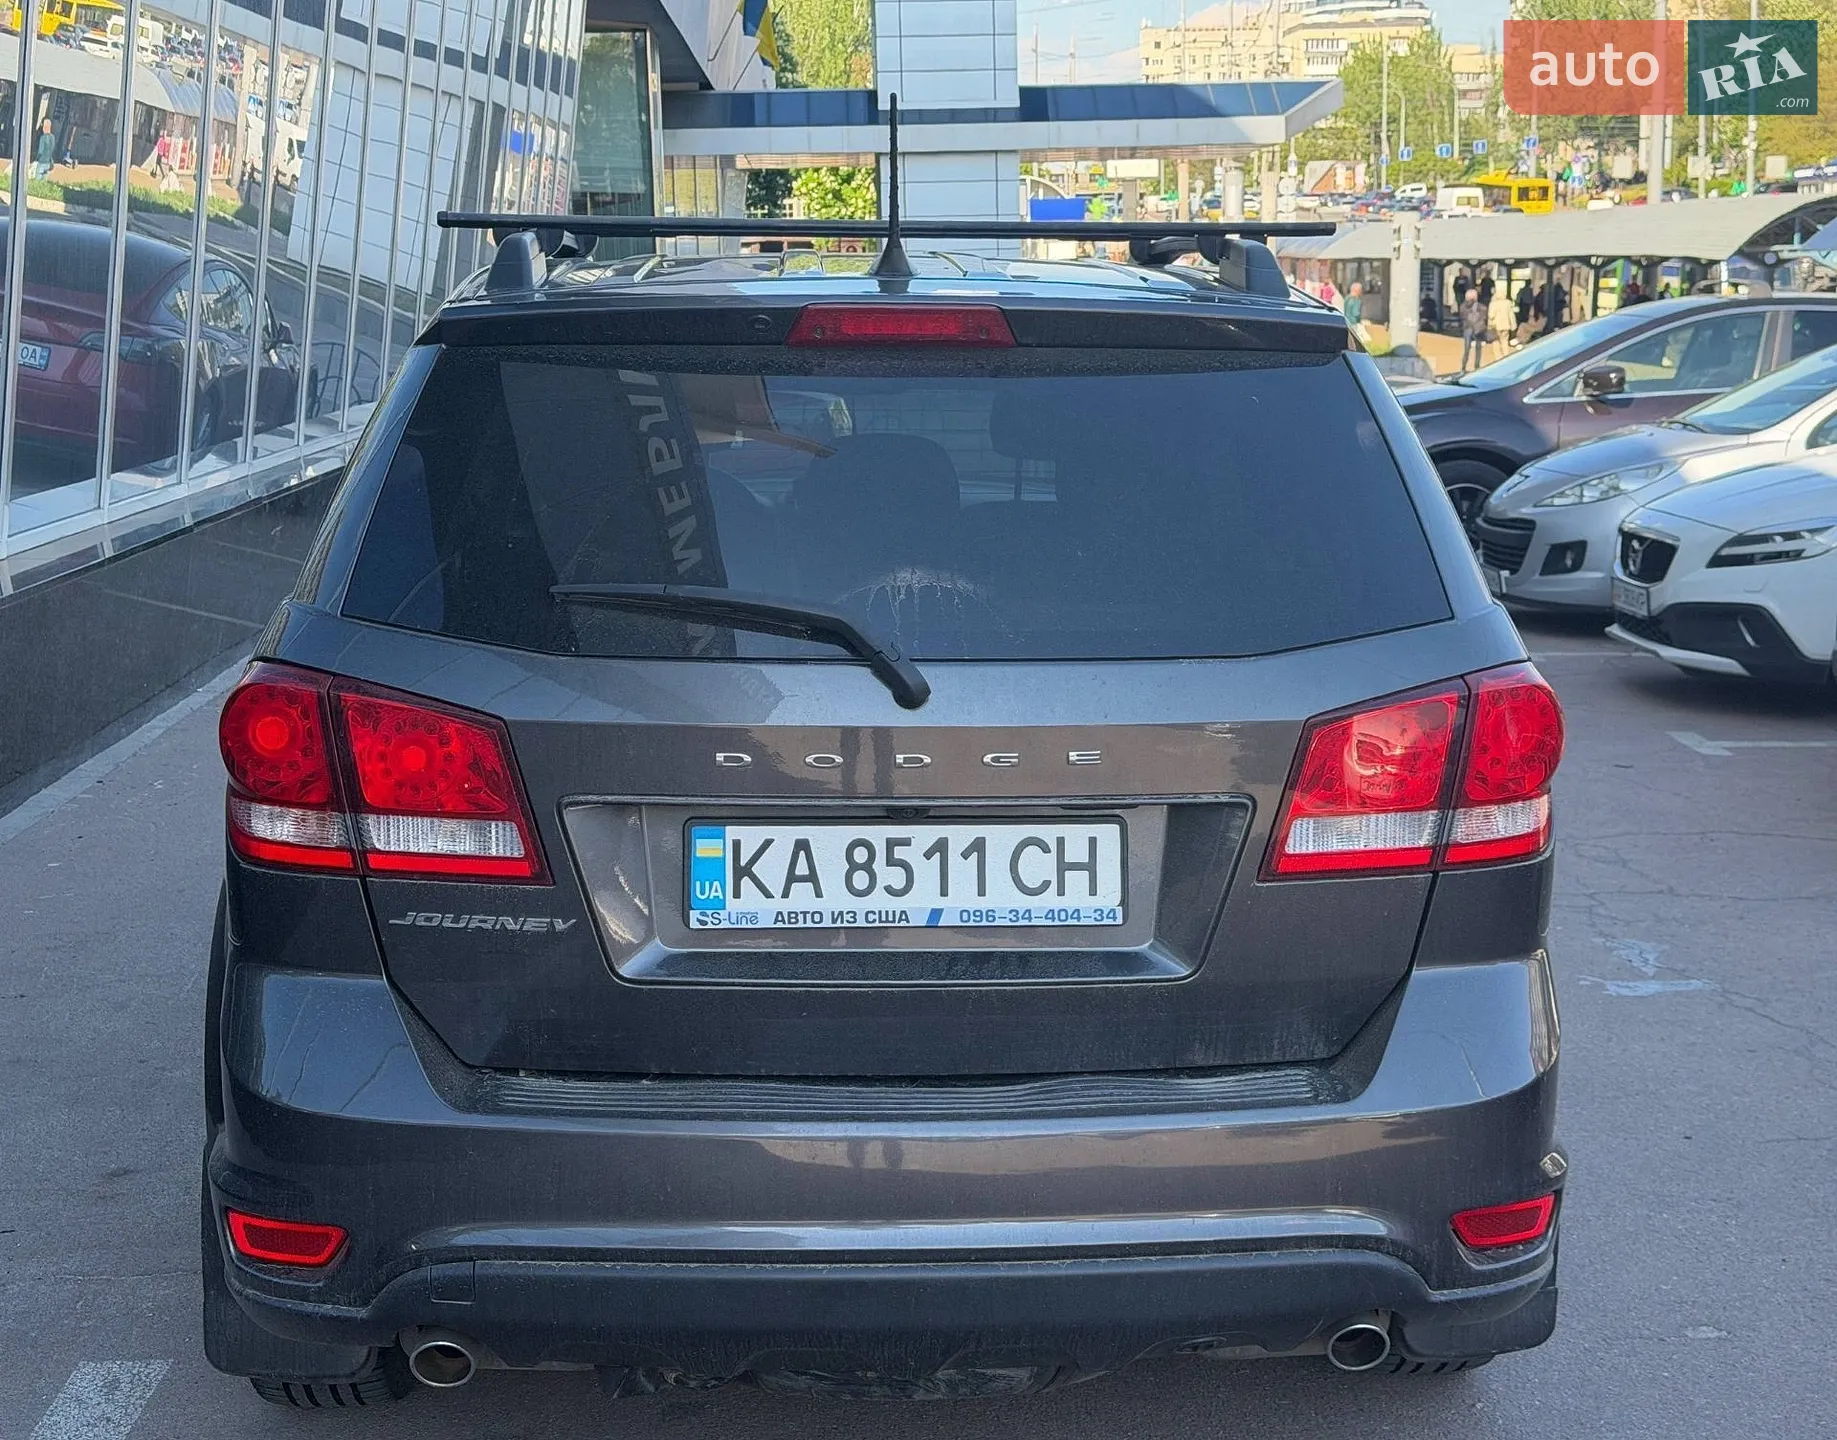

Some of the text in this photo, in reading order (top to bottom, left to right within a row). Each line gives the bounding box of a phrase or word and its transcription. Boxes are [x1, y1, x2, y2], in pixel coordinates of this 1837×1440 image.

[714, 750, 1102, 769] DODGE
[731, 835, 1098, 899] KA 8511 CH
[695, 880, 723, 900] UA
[388, 911, 577, 933] JOURNEY
[772, 909, 911, 926] АВТО ИЗ США
[958, 907, 1119, 924] 096-34-404-34
